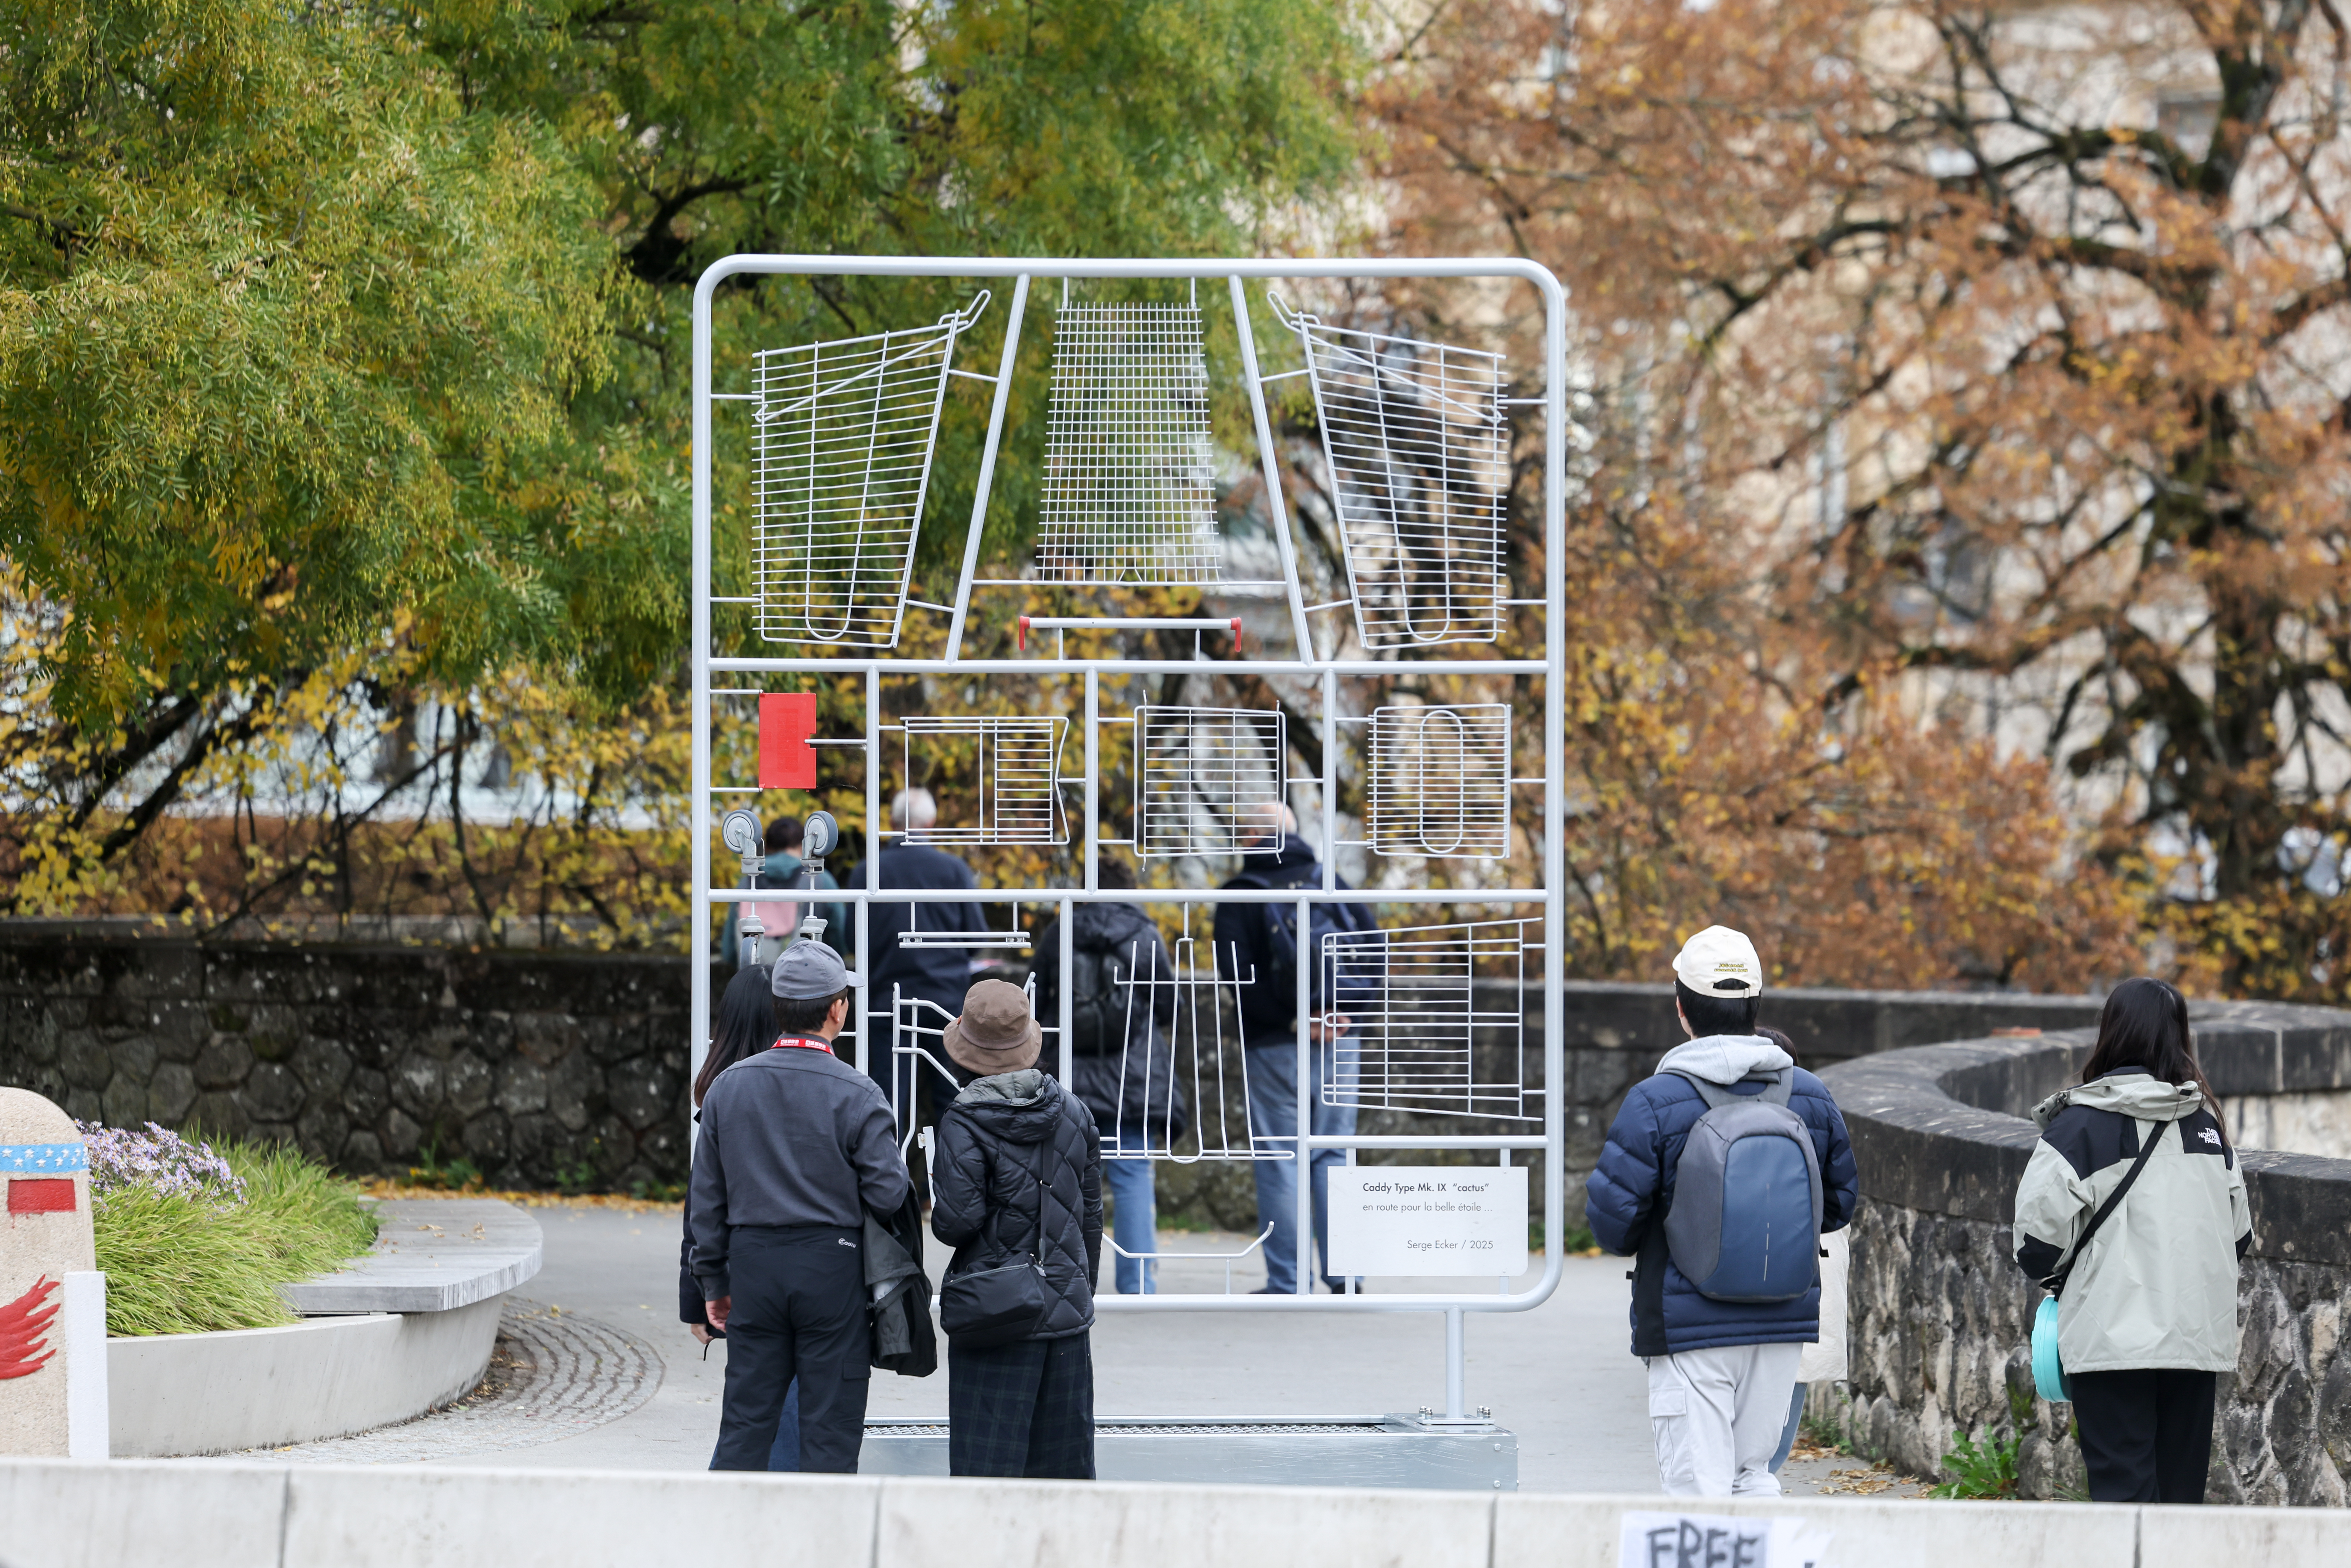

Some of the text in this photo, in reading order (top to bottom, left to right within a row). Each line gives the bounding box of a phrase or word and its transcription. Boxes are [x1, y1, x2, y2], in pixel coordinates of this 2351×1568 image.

[2198, 1132, 2217, 1140] NORTH
[1363, 1182, 1392, 1194] Caddy
[1394, 1183, 1415, 1194] Type
[1418, 1182, 1435, 1192] Mk.
[1438, 1183, 1447, 1192] IX
[1401, 1205, 1421, 1213] pour
[1424, 1202, 1432, 1211] la
[1435, 1202, 1455, 1211] belle
[1458, 1202, 1482, 1211] étoile
[1407, 1239, 1493, 1251] Serge Ecker / 2025
[1647, 1519, 1758, 1568] FREE
